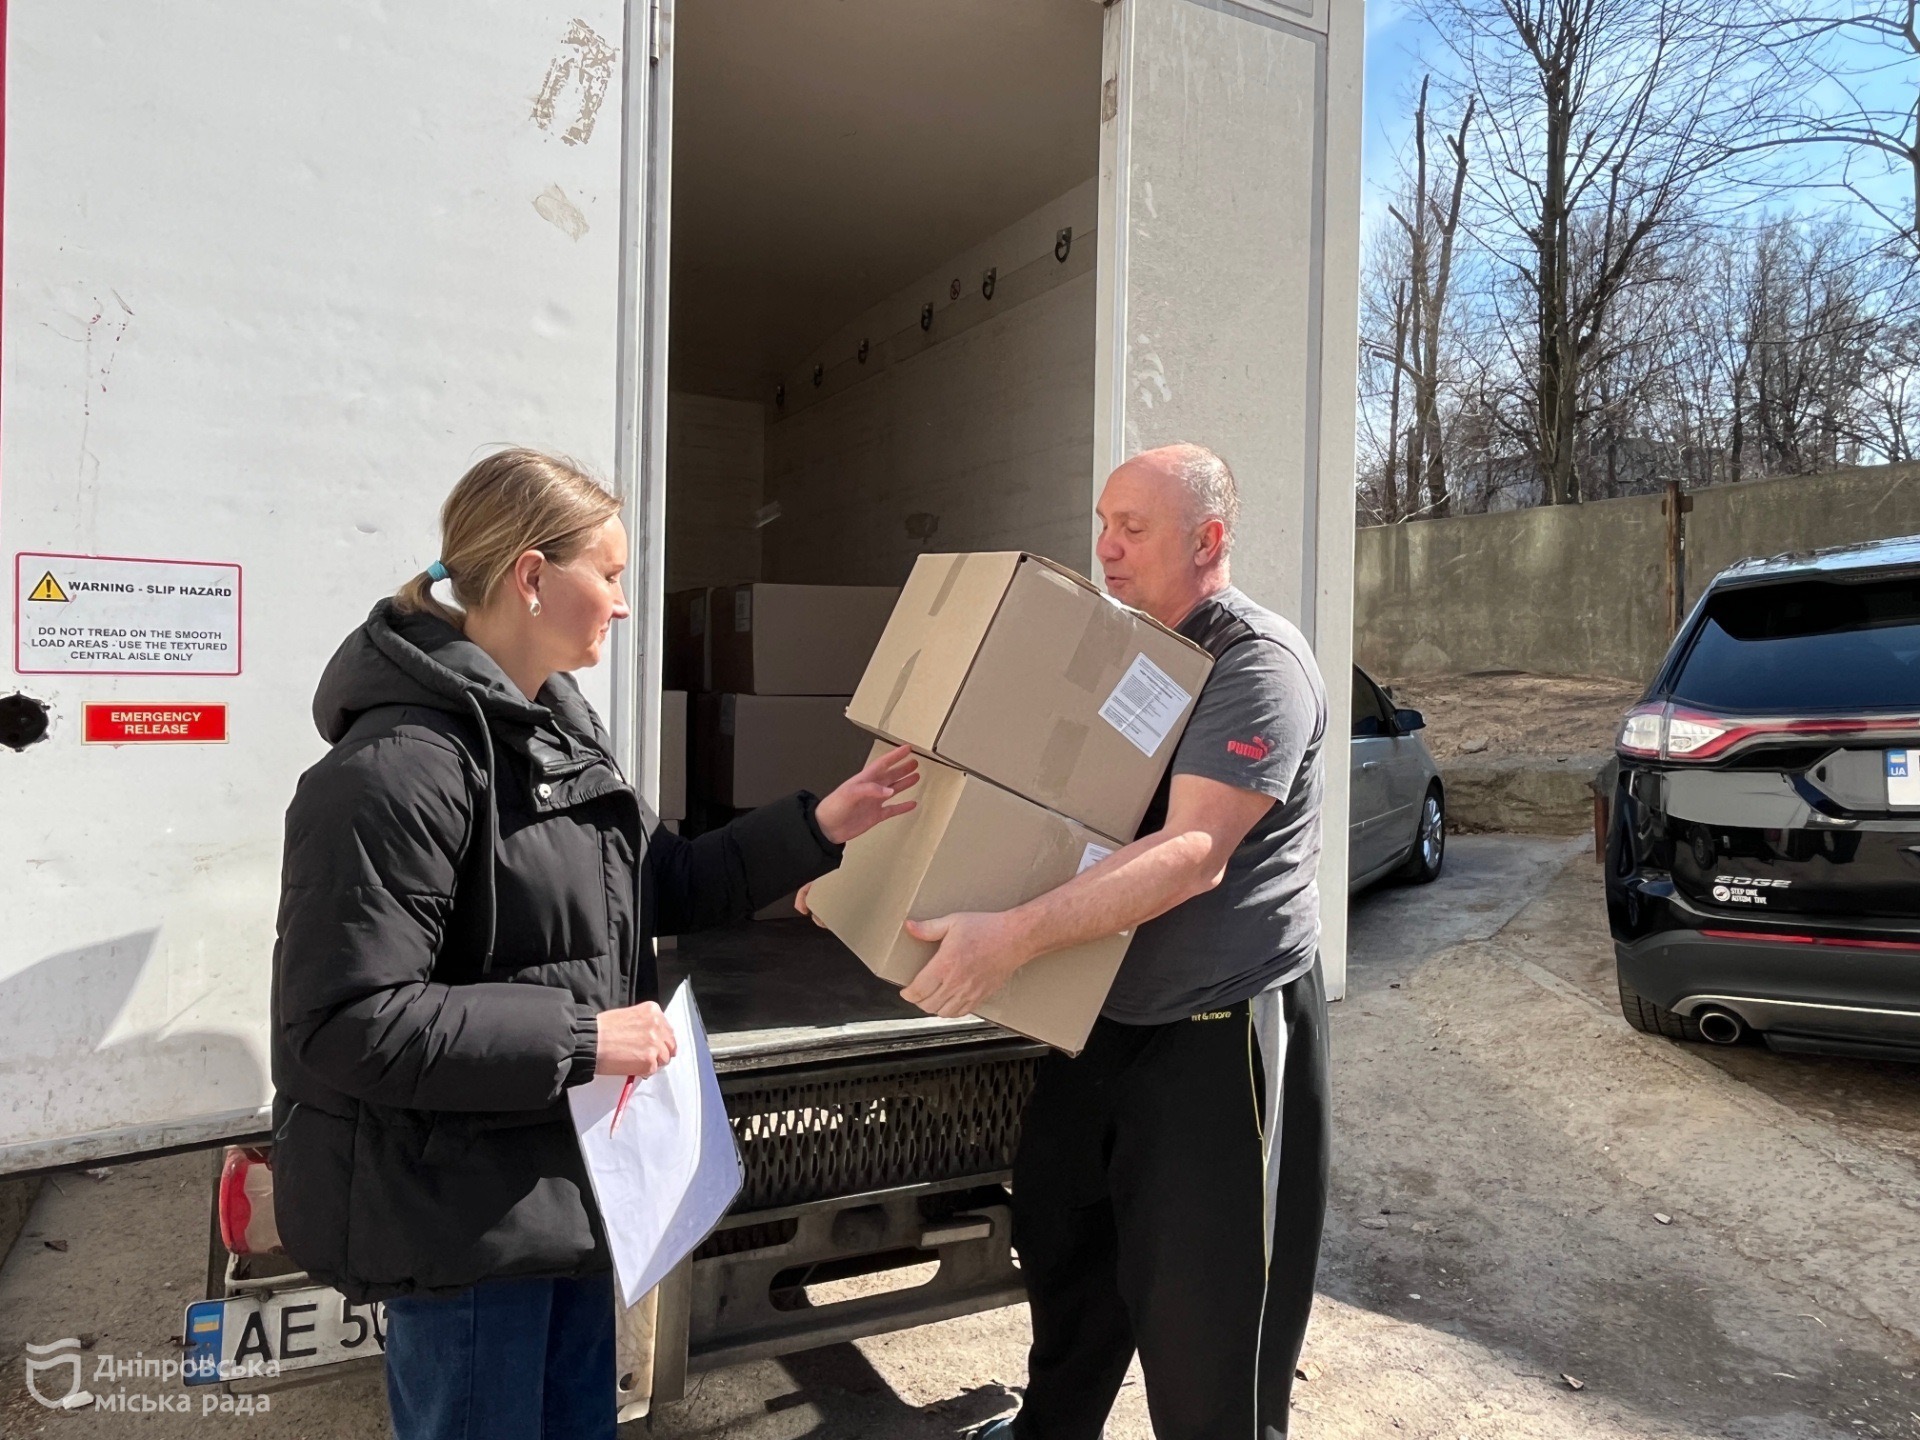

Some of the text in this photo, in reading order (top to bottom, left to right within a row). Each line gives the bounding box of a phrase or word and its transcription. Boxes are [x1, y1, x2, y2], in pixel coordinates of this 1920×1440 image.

[69, 581, 134, 593] WARNING
[147, 585, 175, 595] SLIP
[180, 586, 232, 597] HAZARD
[38, 626, 222, 640] DO NOT TREAD ON THE SMOOTH
[31, 638, 65, 648] LOAD
[68, 639, 108, 648] AREAS
[118, 640, 142, 650] USE
[145, 641, 167, 650] THE
[170, 641, 227, 651] TEXTURED
[70, 651, 193, 662] CENTRAL AISLE ONLY
[111, 711, 201, 722] EMERGENCY
[124, 724, 188, 734] RELEASE
[1891, 767, 1906, 776] UA
[1714, 875, 1792, 888] EDGE
[1209, 1011, 1232, 1020] more
[233, 1303, 318, 1366] AE
